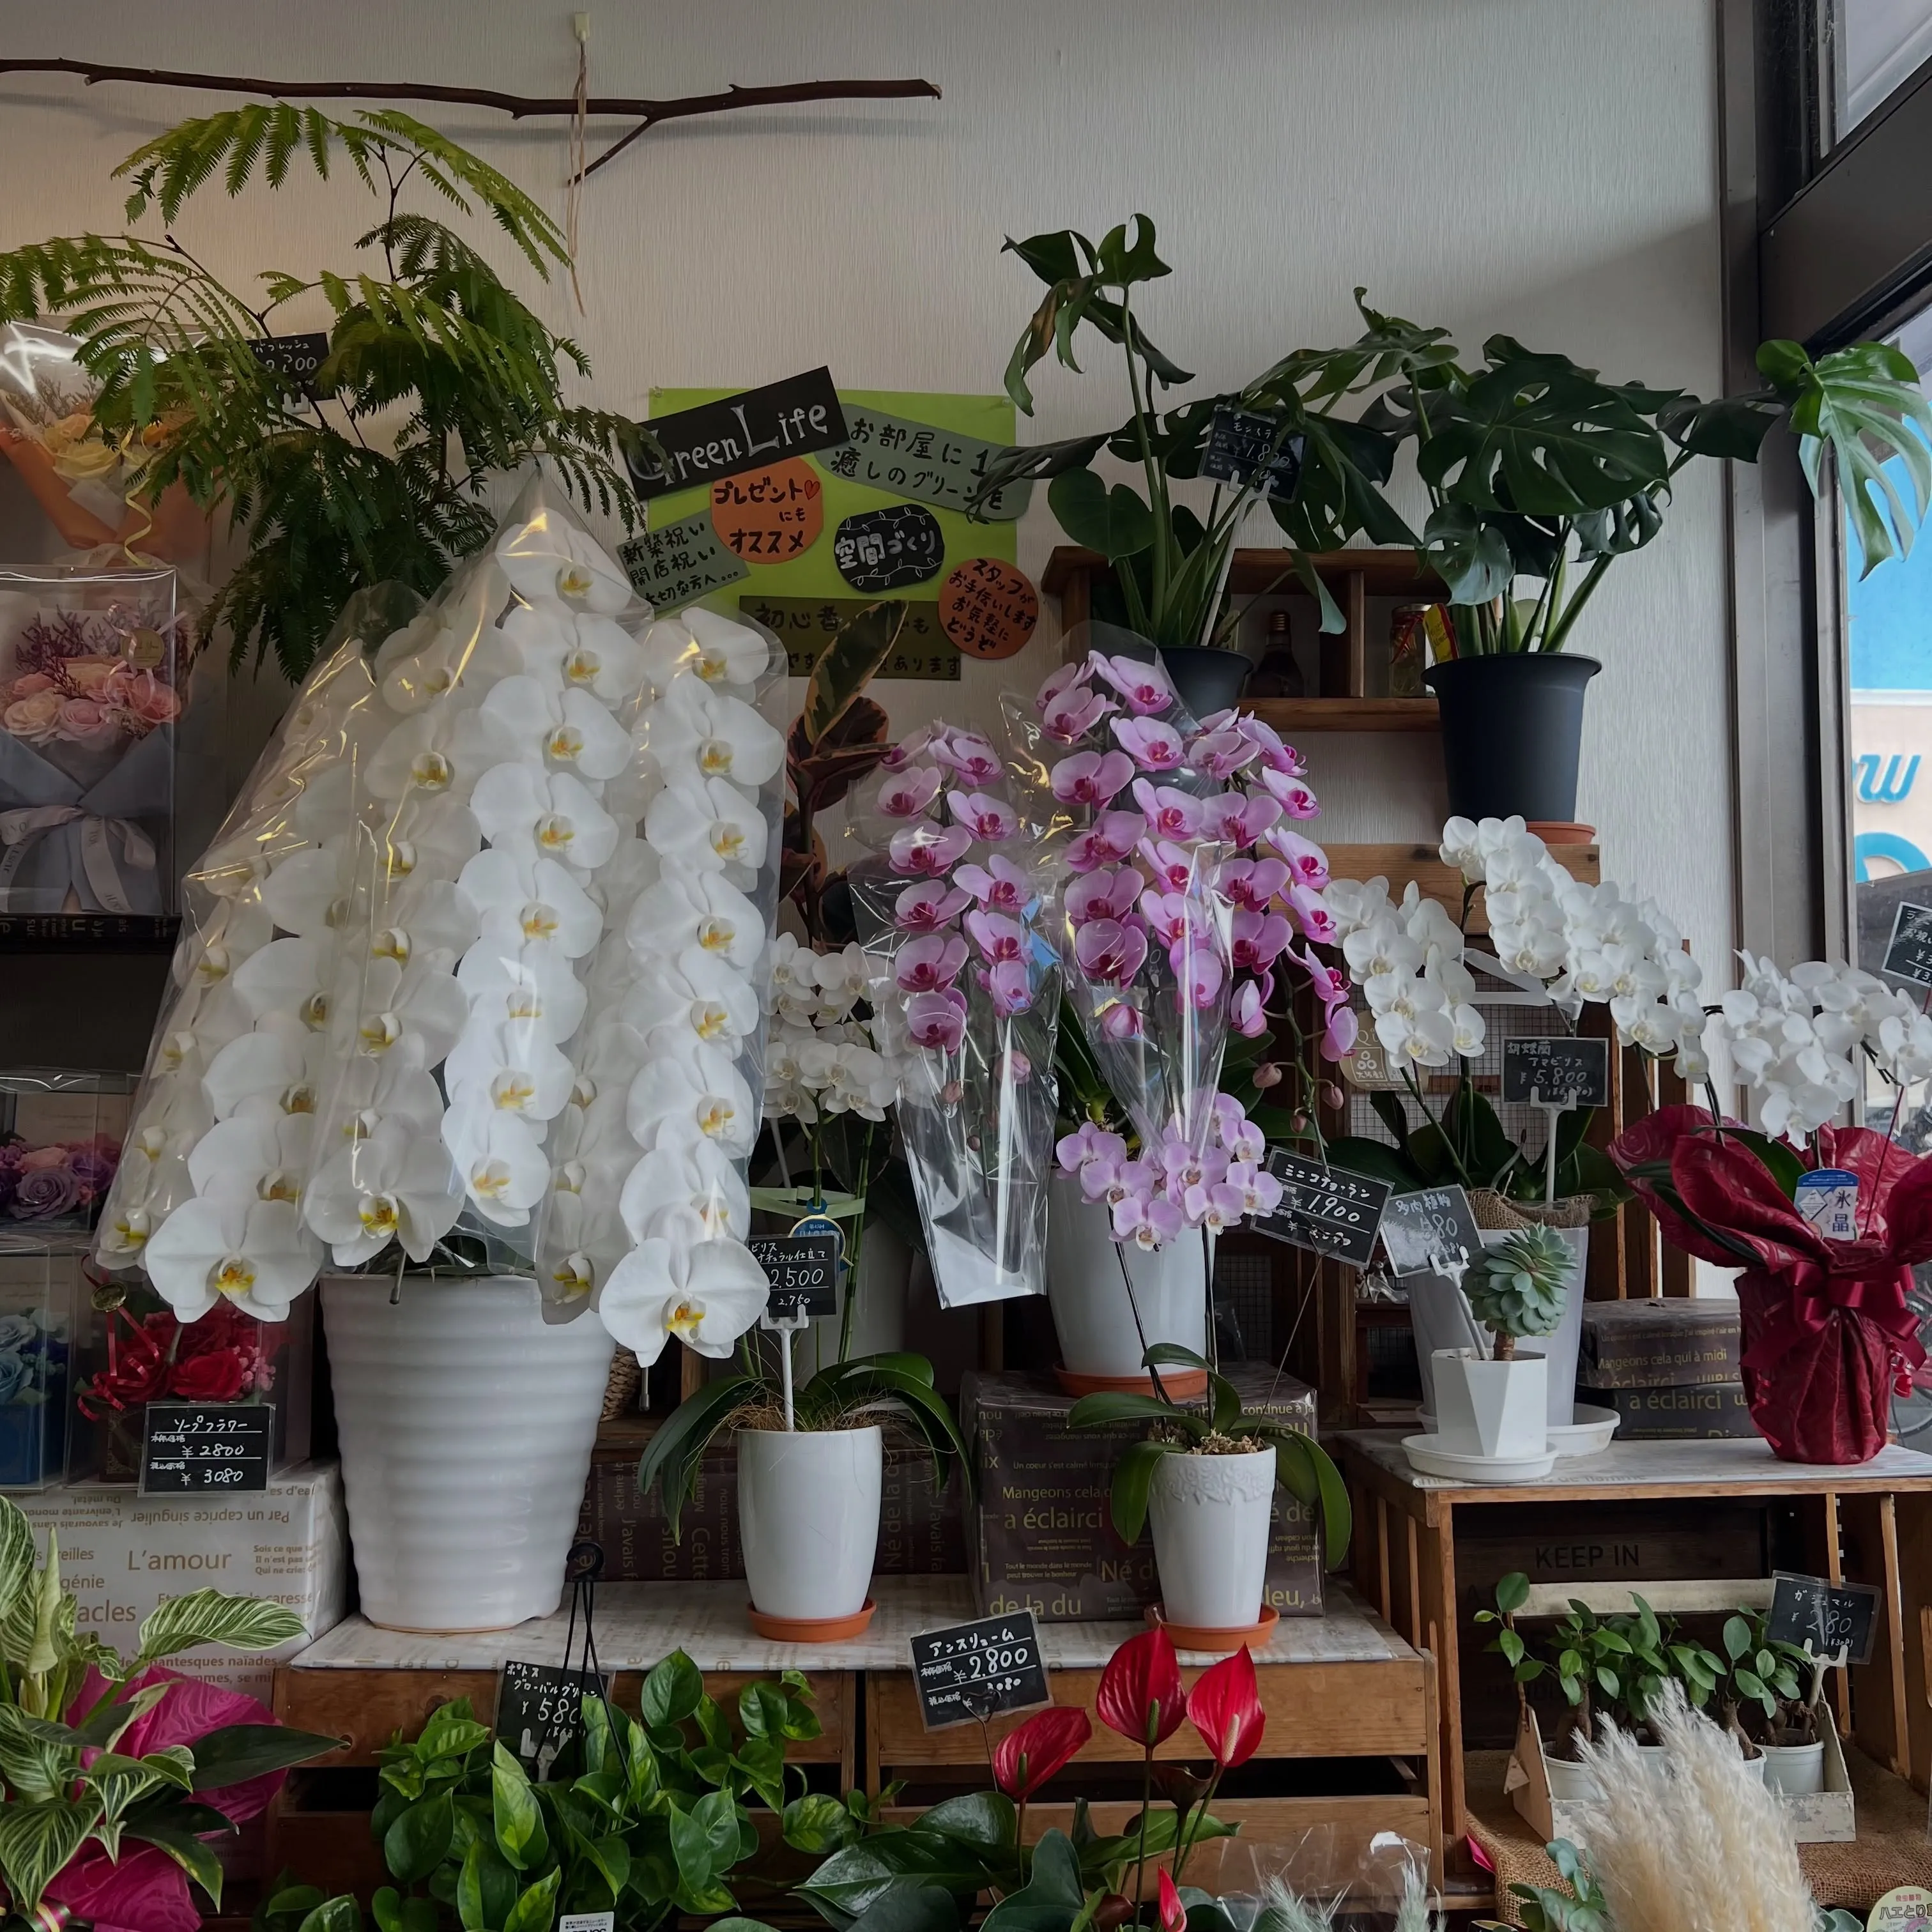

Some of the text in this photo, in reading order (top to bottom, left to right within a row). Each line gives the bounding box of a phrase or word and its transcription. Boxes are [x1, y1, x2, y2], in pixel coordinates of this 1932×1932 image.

[730, 404, 828, 457] Life
[714, 475, 802, 505] プレゼント
[779, 507, 806, 523] にも
[622, 522, 705, 565] 新築祝い
[729, 528, 804, 554] オススメ
[835, 530, 935, 569] 空間づくり
[629, 546, 716, 586] 開店祝い
[972, 558, 1034, 604] スタッフが
[949, 570, 1036, 631] お手伝いします
[952, 595, 1009, 641] お気軽に
[947, 617, 997, 651] どうぞ
[1528, 1056, 1583, 1067] アマビリス
[1308, 1194, 1360, 1223] 1.900
[1395, 1193, 1451, 1215] 多肉植物
[770, 1266, 825, 1289] 2.500
[778, 1293, 811, 1306] 2.750
[1651, 1351, 1671, 1365] cela
[1674, 1351, 1692, 1367] qui
[1703, 1348, 1727, 1361] midi
[1630, 1390, 1722, 1409] a éclairci
[174, 1415, 248, 1432] ソープフラワー
[181, 1443, 245, 1458] ¥ 2800
[181, 1468, 244, 1486] ¥ 3080
[107, 1496, 121, 1504] Du
[1002, 1485, 1100, 1501] Mangeons cela
[130, 1508, 290, 1526] Par un caprice singulier
[1004, 1506, 1103, 1529] a éclairci
[1286, 1501, 1315, 1522] de
[60, 1520, 109, 1528] savourais
[622, 1519, 638, 1568] J'avais
[128, 1550, 232, 1571] L'amour
[1536, 1544, 1640, 1569] KEEP IN
[1101, 1557, 1133, 1583] Né
[61, 1574, 105, 1591] génie
[1052, 1593, 1082, 1616] du
[929, 1628, 1015, 1657] アンスリューム
[506, 1663, 540, 1678] ポトス
[953, 1647, 1029, 1684] ¥ 2.800
[237, 1673, 250, 1683] se
